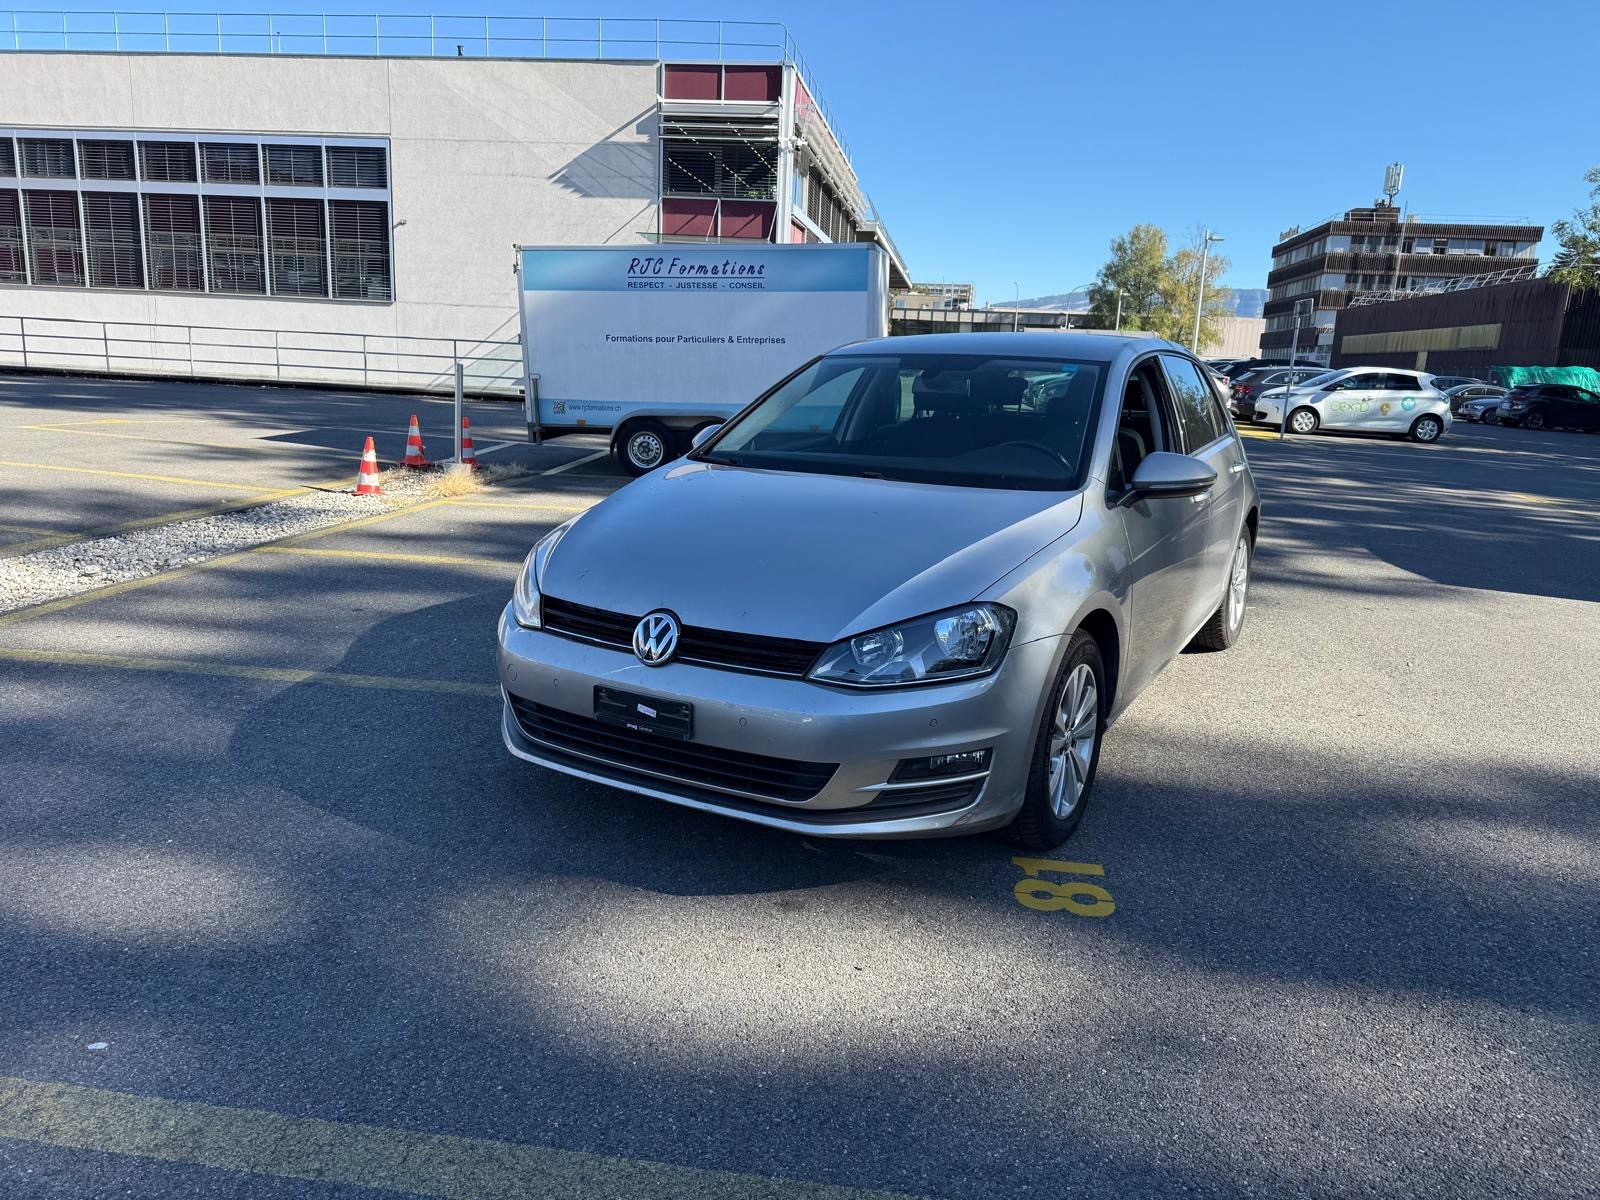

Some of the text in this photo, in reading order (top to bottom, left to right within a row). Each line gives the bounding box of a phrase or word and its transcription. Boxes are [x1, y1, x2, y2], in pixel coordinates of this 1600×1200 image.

[627, 257, 765, 275] RJC Formations
[627, 281, 665, 289] RESPECT
[676, 281, 718, 289] JUSTESSE
[729, 281, 765, 289] CONSEIL
[605, 334, 786, 346] Formations pour Particuliers & Entreprises
